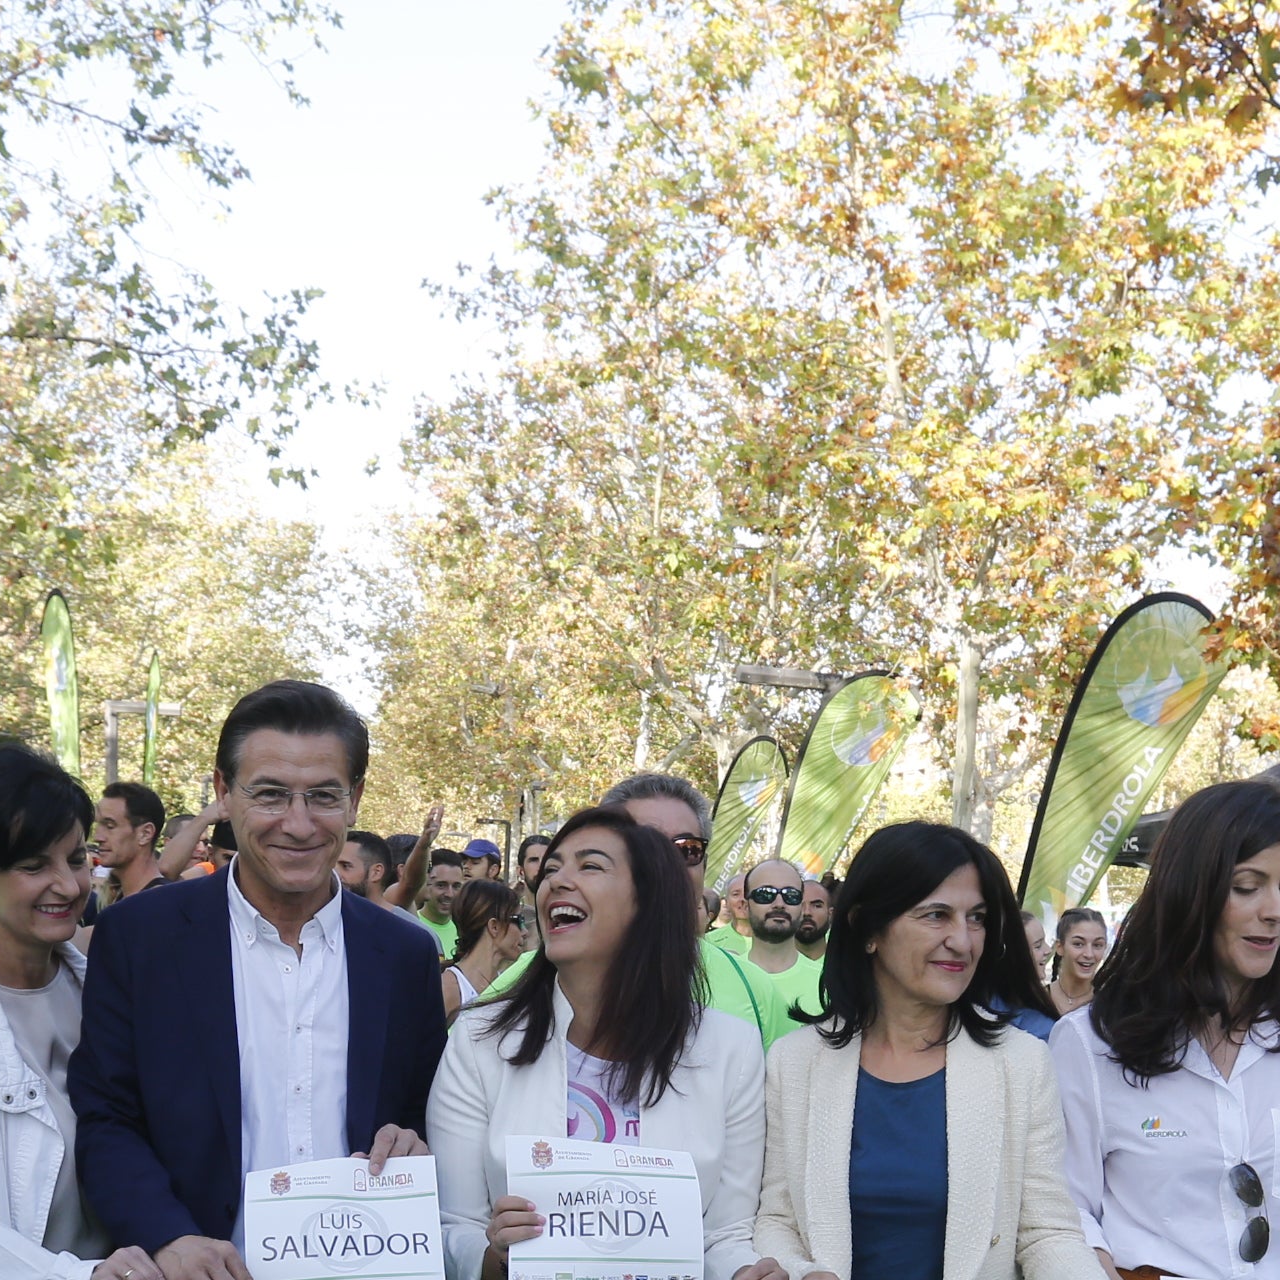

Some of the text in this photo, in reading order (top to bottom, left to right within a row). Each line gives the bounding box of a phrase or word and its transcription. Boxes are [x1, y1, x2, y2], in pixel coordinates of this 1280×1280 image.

[1066, 745, 1164, 894] IBERDROLA
[712, 815, 757, 896] IBERDROLA
[629, 1154, 674, 1168] GRANADA
[369, 1173, 414, 1186] GRANADA
[557, 1187, 657, 1207] MARÍA JOSÉ
[320, 1212, 363, 1230] LUIS
[548, 1210, 669, 1238] RIENDA
[261, 1232, 431, 1262] SALVADOR
